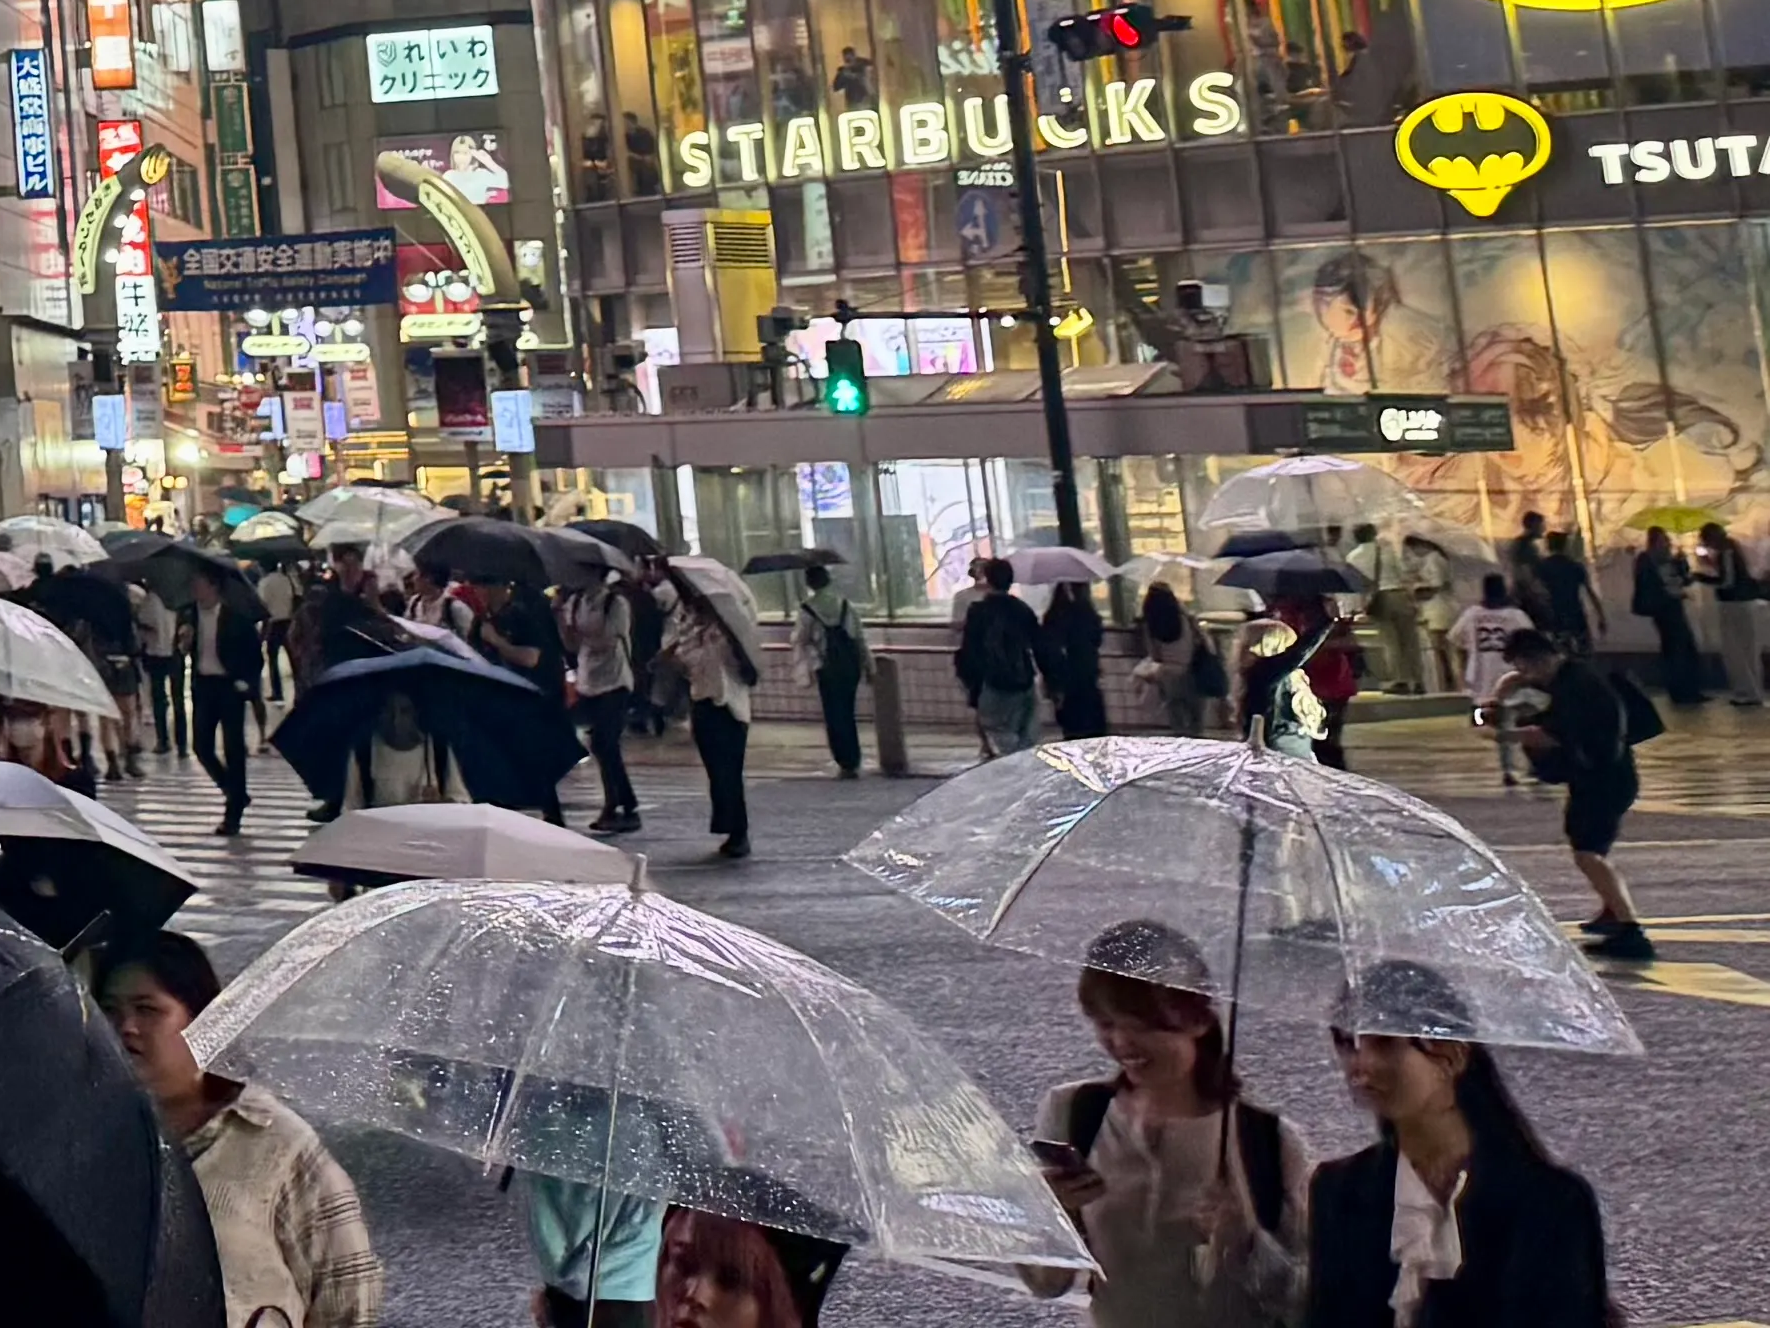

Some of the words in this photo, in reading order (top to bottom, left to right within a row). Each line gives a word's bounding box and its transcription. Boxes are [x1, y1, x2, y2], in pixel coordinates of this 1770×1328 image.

[403, 36, 489, 65] れいわ
[378, 68, 491, 95] クリニック
[679, 71, 1243, 188] STARBUCKS
